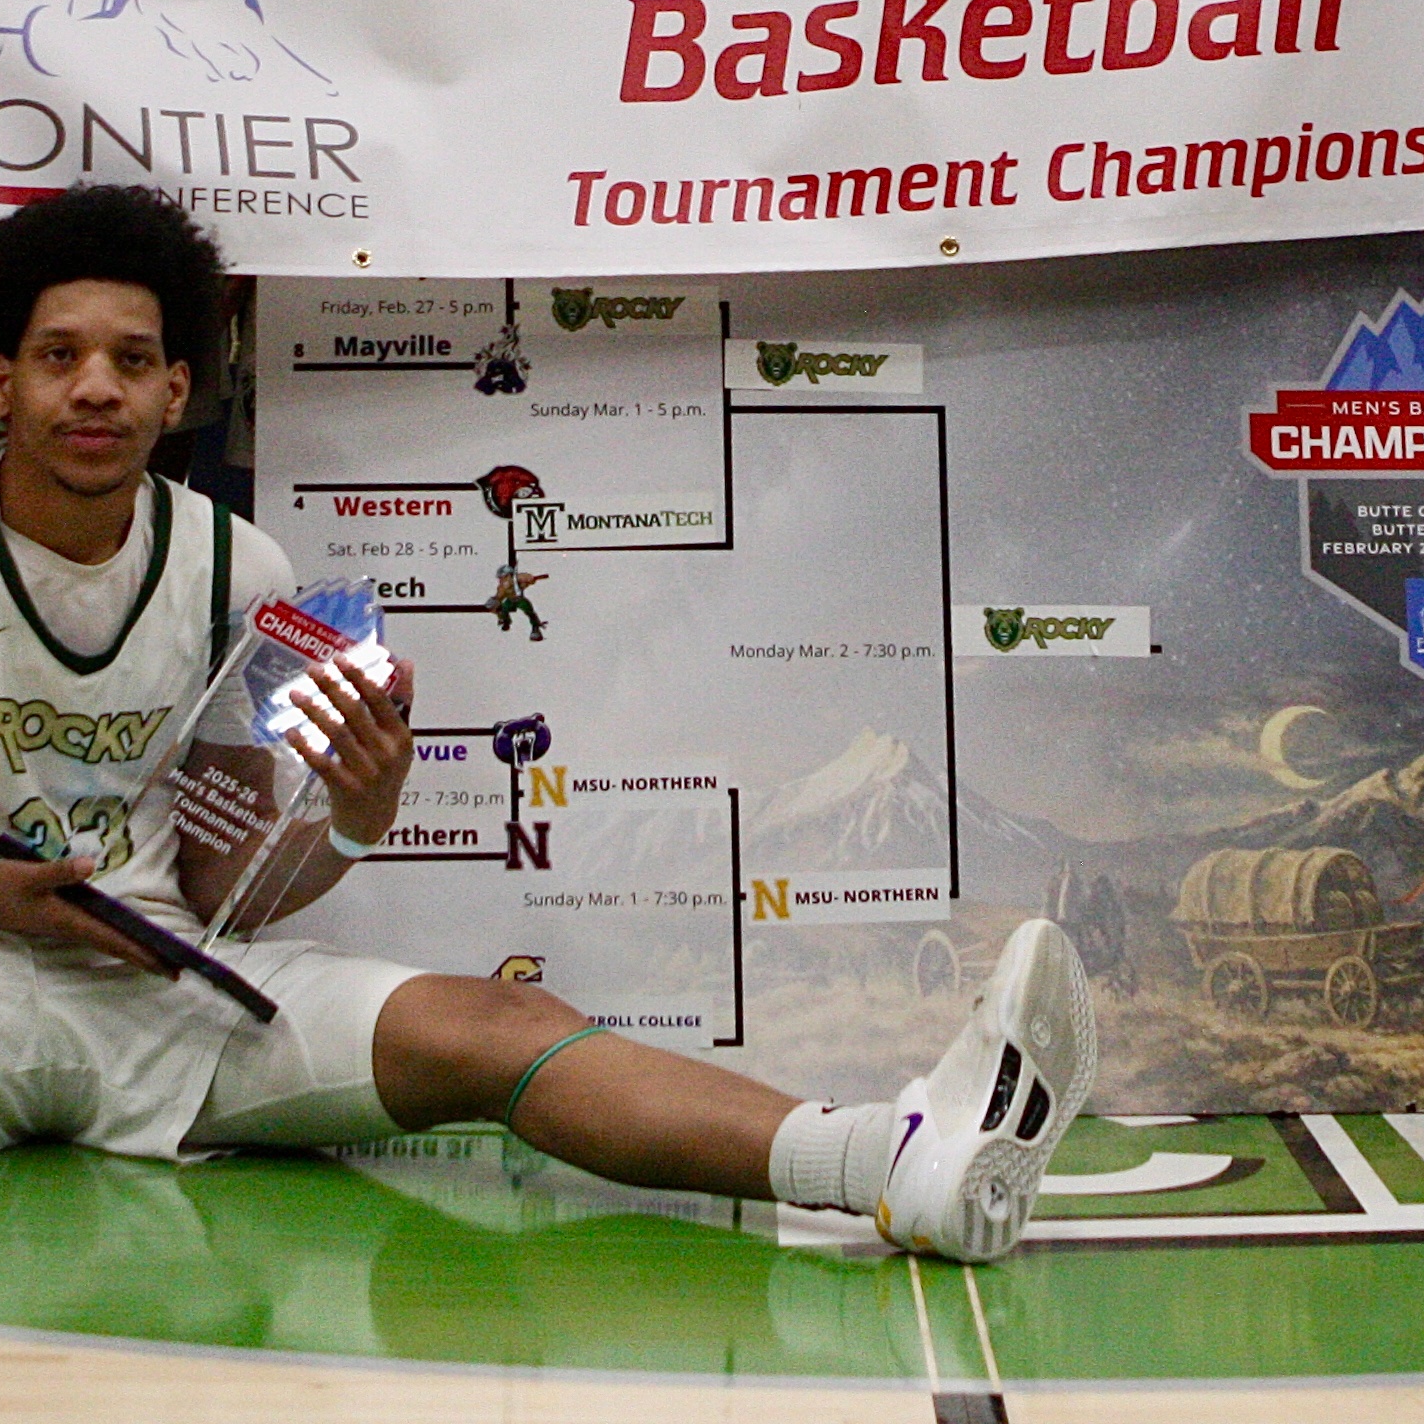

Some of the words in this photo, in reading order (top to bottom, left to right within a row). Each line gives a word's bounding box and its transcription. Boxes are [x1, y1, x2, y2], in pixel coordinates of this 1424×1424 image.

[567, 150, 1019, 227] Tournament
[158, 187, 369, 219] NFERENCE
[321, 301, 373, 316] Friday,
[379, 300, 410, 315] Feb.
[416, 300, 434, 314] 27
[450, 300, 458, 314] 5
[592, 296, 685, 329] ROCKY
[294, 343, 304, 358] 8
[334, 335, 452, 361] Mayville
[794, 352, 890, 384] ROCKY
[531, 402, 590, 419] Sunday
[593, 403, 628, 416] Mar.
[635, 403, 642, 416] 1
[658, 403, 667, 416] 5
[1332, 401, 1400, 416] MEN'S
[293, 496, 305, 510] 4
[333, 496, 453, 517] Western
[1357, 505, 1413, 518] BUTTE
[327, 543, 357, 556] Sat.
[362, 542, 390, 556] Feb
[395, 542, 414, 556] 28
[429, 543, 439, 556] 5
[1323, 543, 1411, 555] FEBRUARY
[373, 577, 425, 599] ech
[259, 612, 336, 663] CHAMPIO
[1023, 617, 1116, 649] ROCKY
[731, 643, 794, 661] Monday
[798, 644, 835, 658] Mar.
[839, 644, 849, 658] 2
[864, 644, 897, 659] 7:30
[573, 778, 616, 792] MSU-
[621, 776, 717, 792] NORTHERN
[401, 791, 420, 806] 27
[435, 791, 469, 806] 7:30
[174, 790, 249, 844] Tournament
[381, 824, 478, 847] rthern
[524, 891, 583, 909] Sunday
[588, 892, 624, 906] Mar.
[629, 892, 637, 906] 1
[654, 891, 688, 907] 7:30
[795, 891, 839, 906] MSU-
[844, 887, 939, 904] NORTHERN
[638, 1015, 702, 1027] COLLEGE
